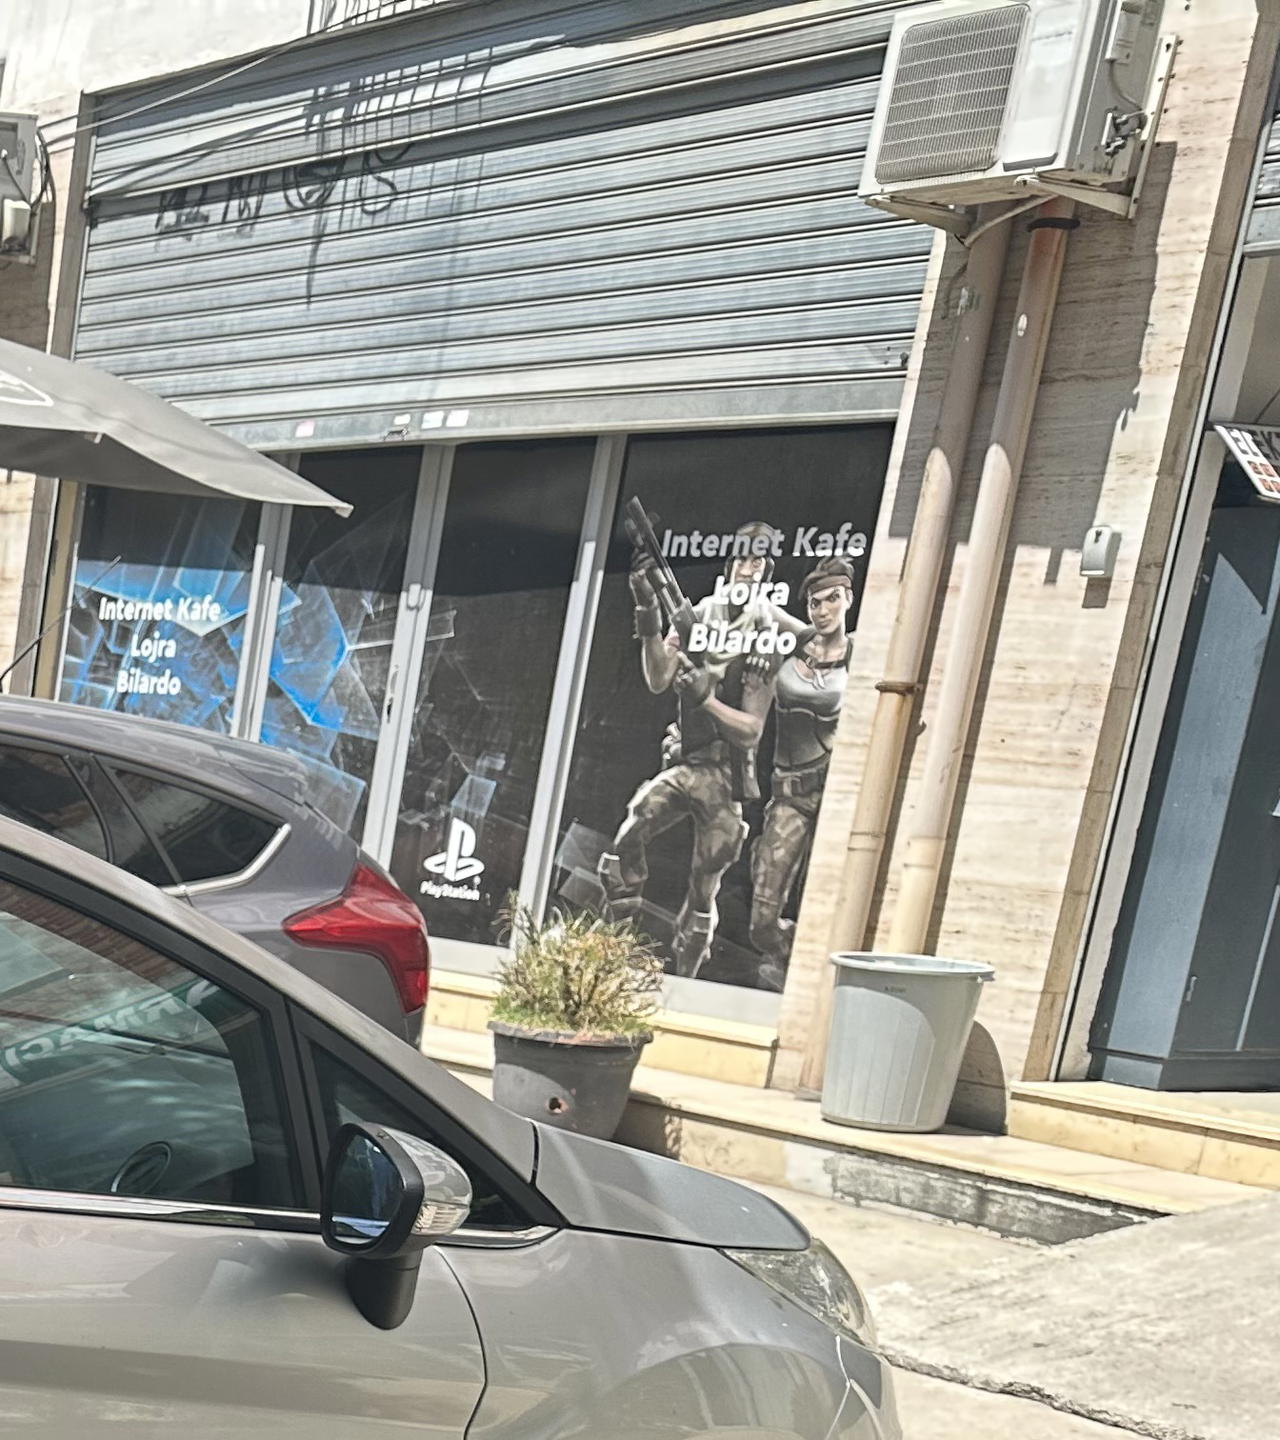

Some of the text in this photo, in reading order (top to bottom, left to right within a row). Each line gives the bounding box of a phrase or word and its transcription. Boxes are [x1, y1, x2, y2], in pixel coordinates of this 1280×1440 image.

[662, 522, 868, 558] Internet Kafe
[99, 594, 221, 621] Internet Kafe
[713, 570, 790, 613] Lojra
[130, 631, 177, 663] Lojra
[688, 622, 797, 655] Bilardo
[116, 667, 181, 695] Bilardo
